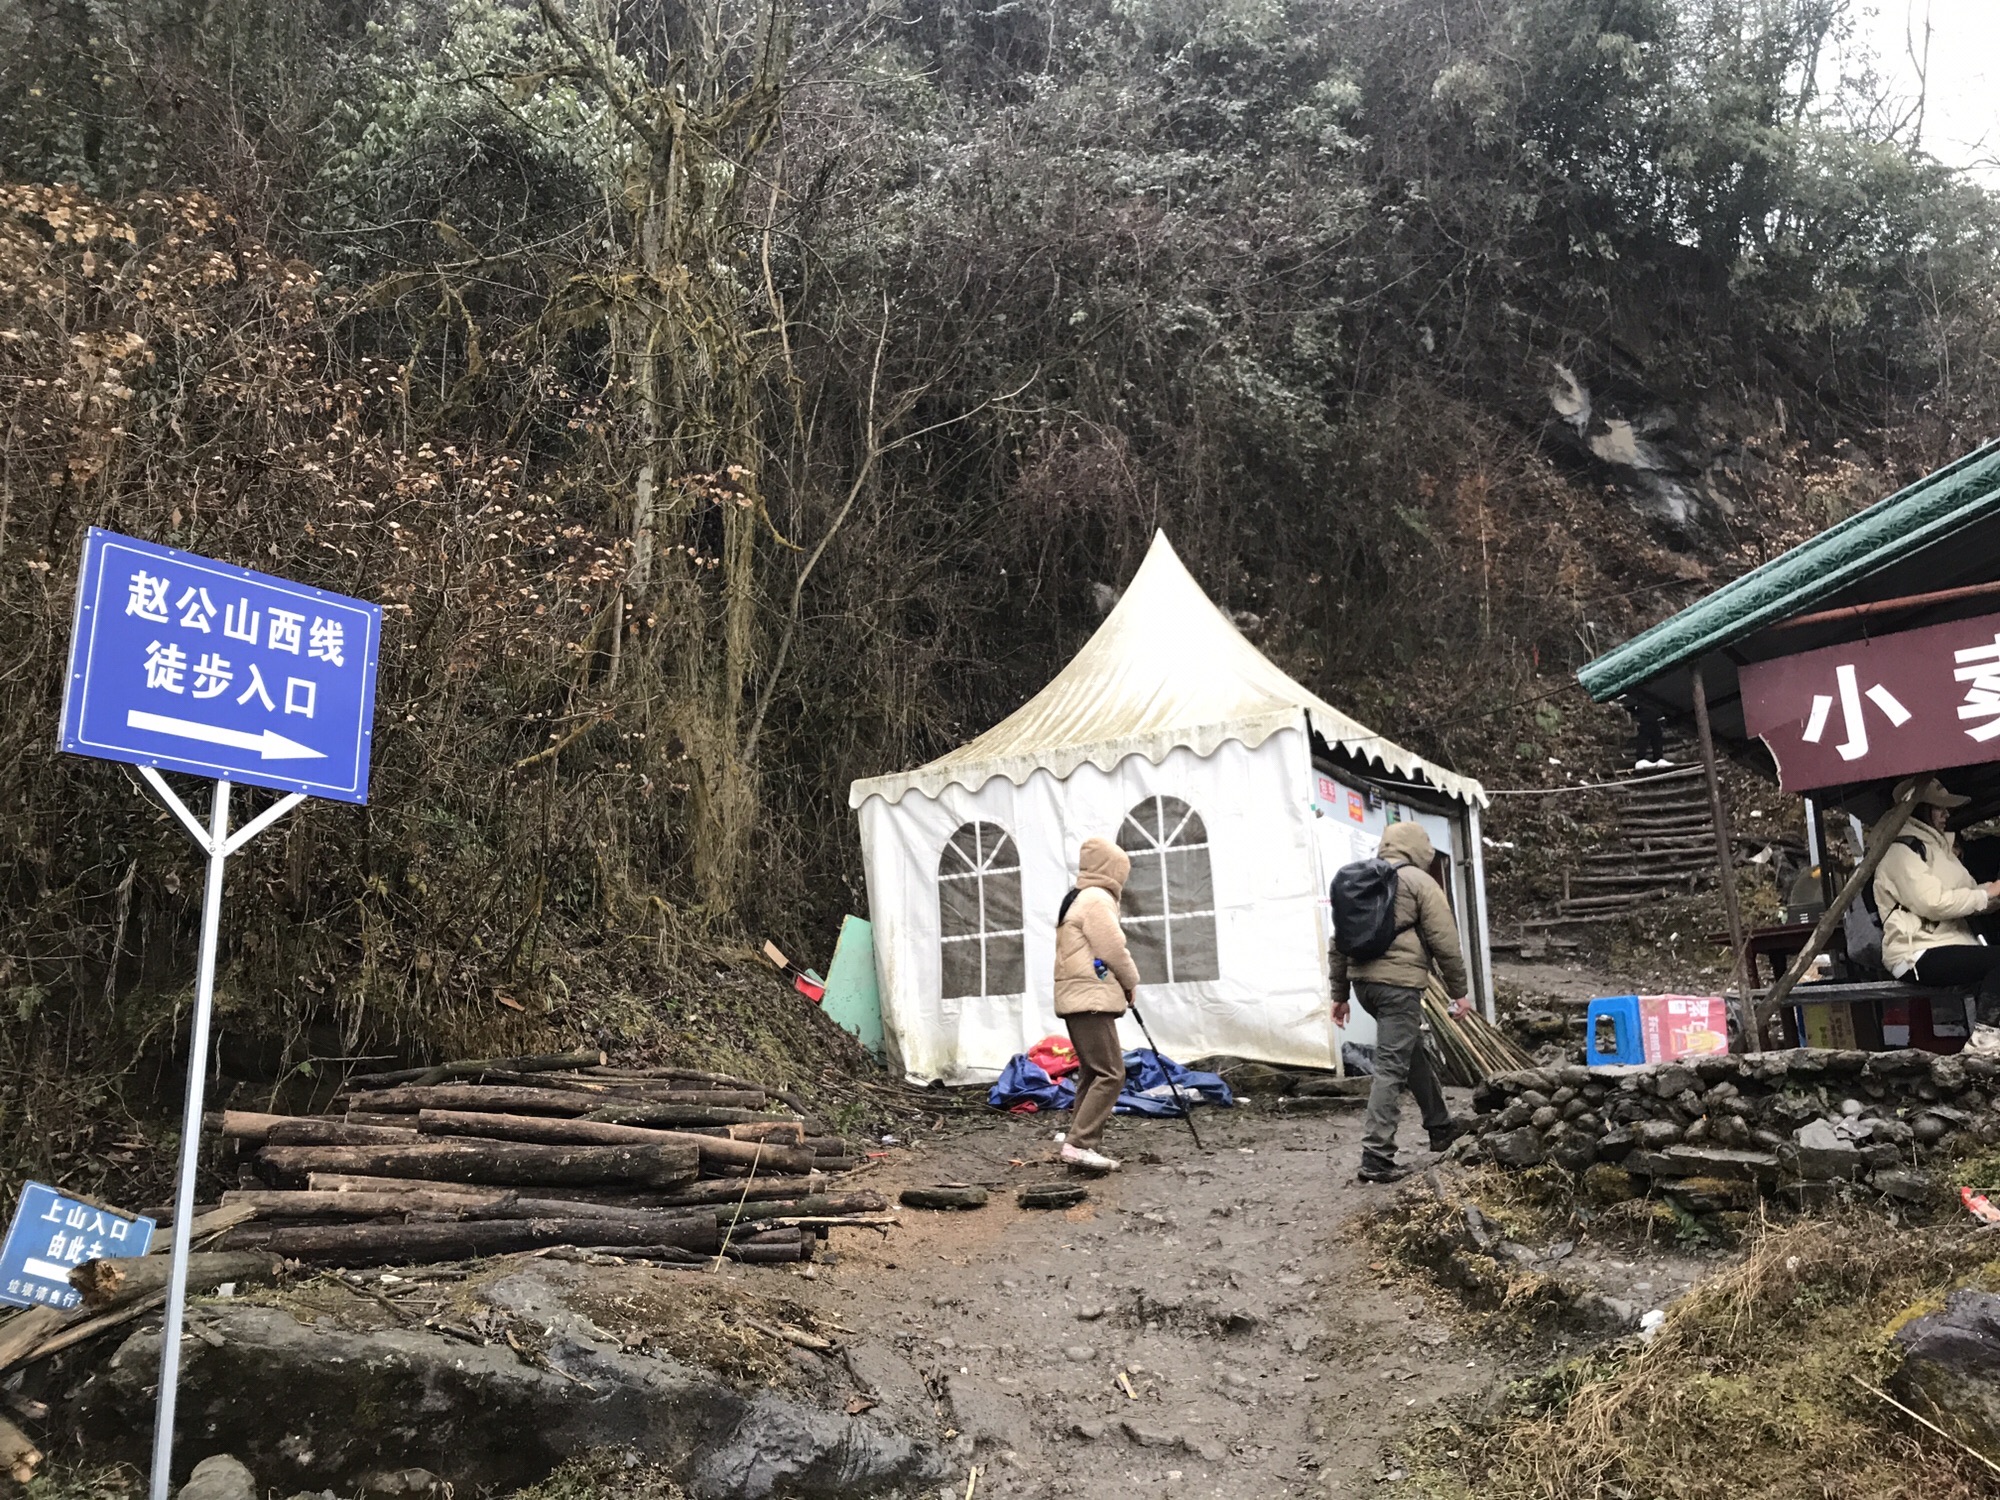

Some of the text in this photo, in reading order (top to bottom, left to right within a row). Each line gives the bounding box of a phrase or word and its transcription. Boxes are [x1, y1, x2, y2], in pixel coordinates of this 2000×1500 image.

[126, 570, 345, 667] 赵公山西线
[144, 640, 317, 719] 徒步入口
[41, 1198, 129, 1242] 上山入口
[7, 1279, 83, 1308] 垃圾请自行
